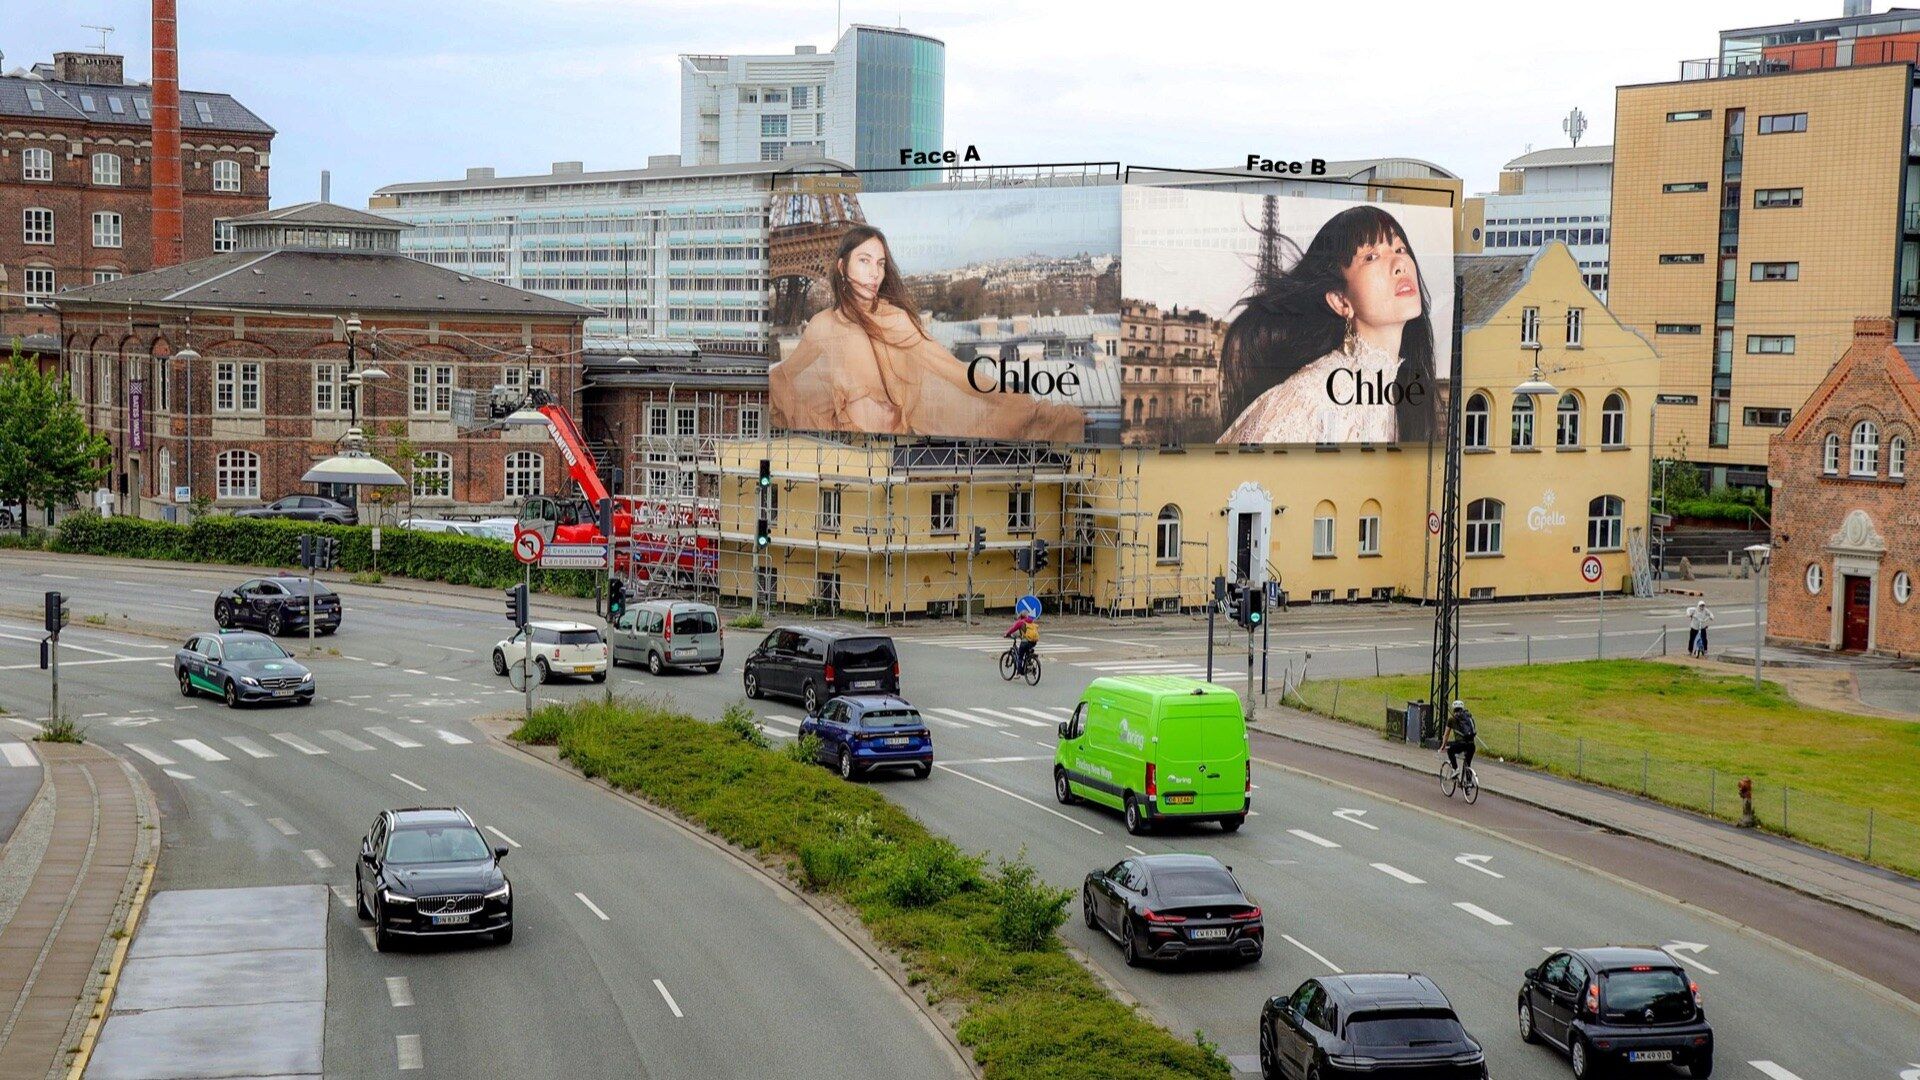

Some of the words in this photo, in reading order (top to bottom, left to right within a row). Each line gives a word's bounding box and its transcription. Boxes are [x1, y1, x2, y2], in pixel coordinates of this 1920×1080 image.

[967, 356, 1080, 396] Chloé
[1326, 367, 1425, 406] Chloé
[1430, 518, 1439, 529] 40
[1527, 505, 1567, 531] Capella
[1585, 564, 1599, 574] 40
